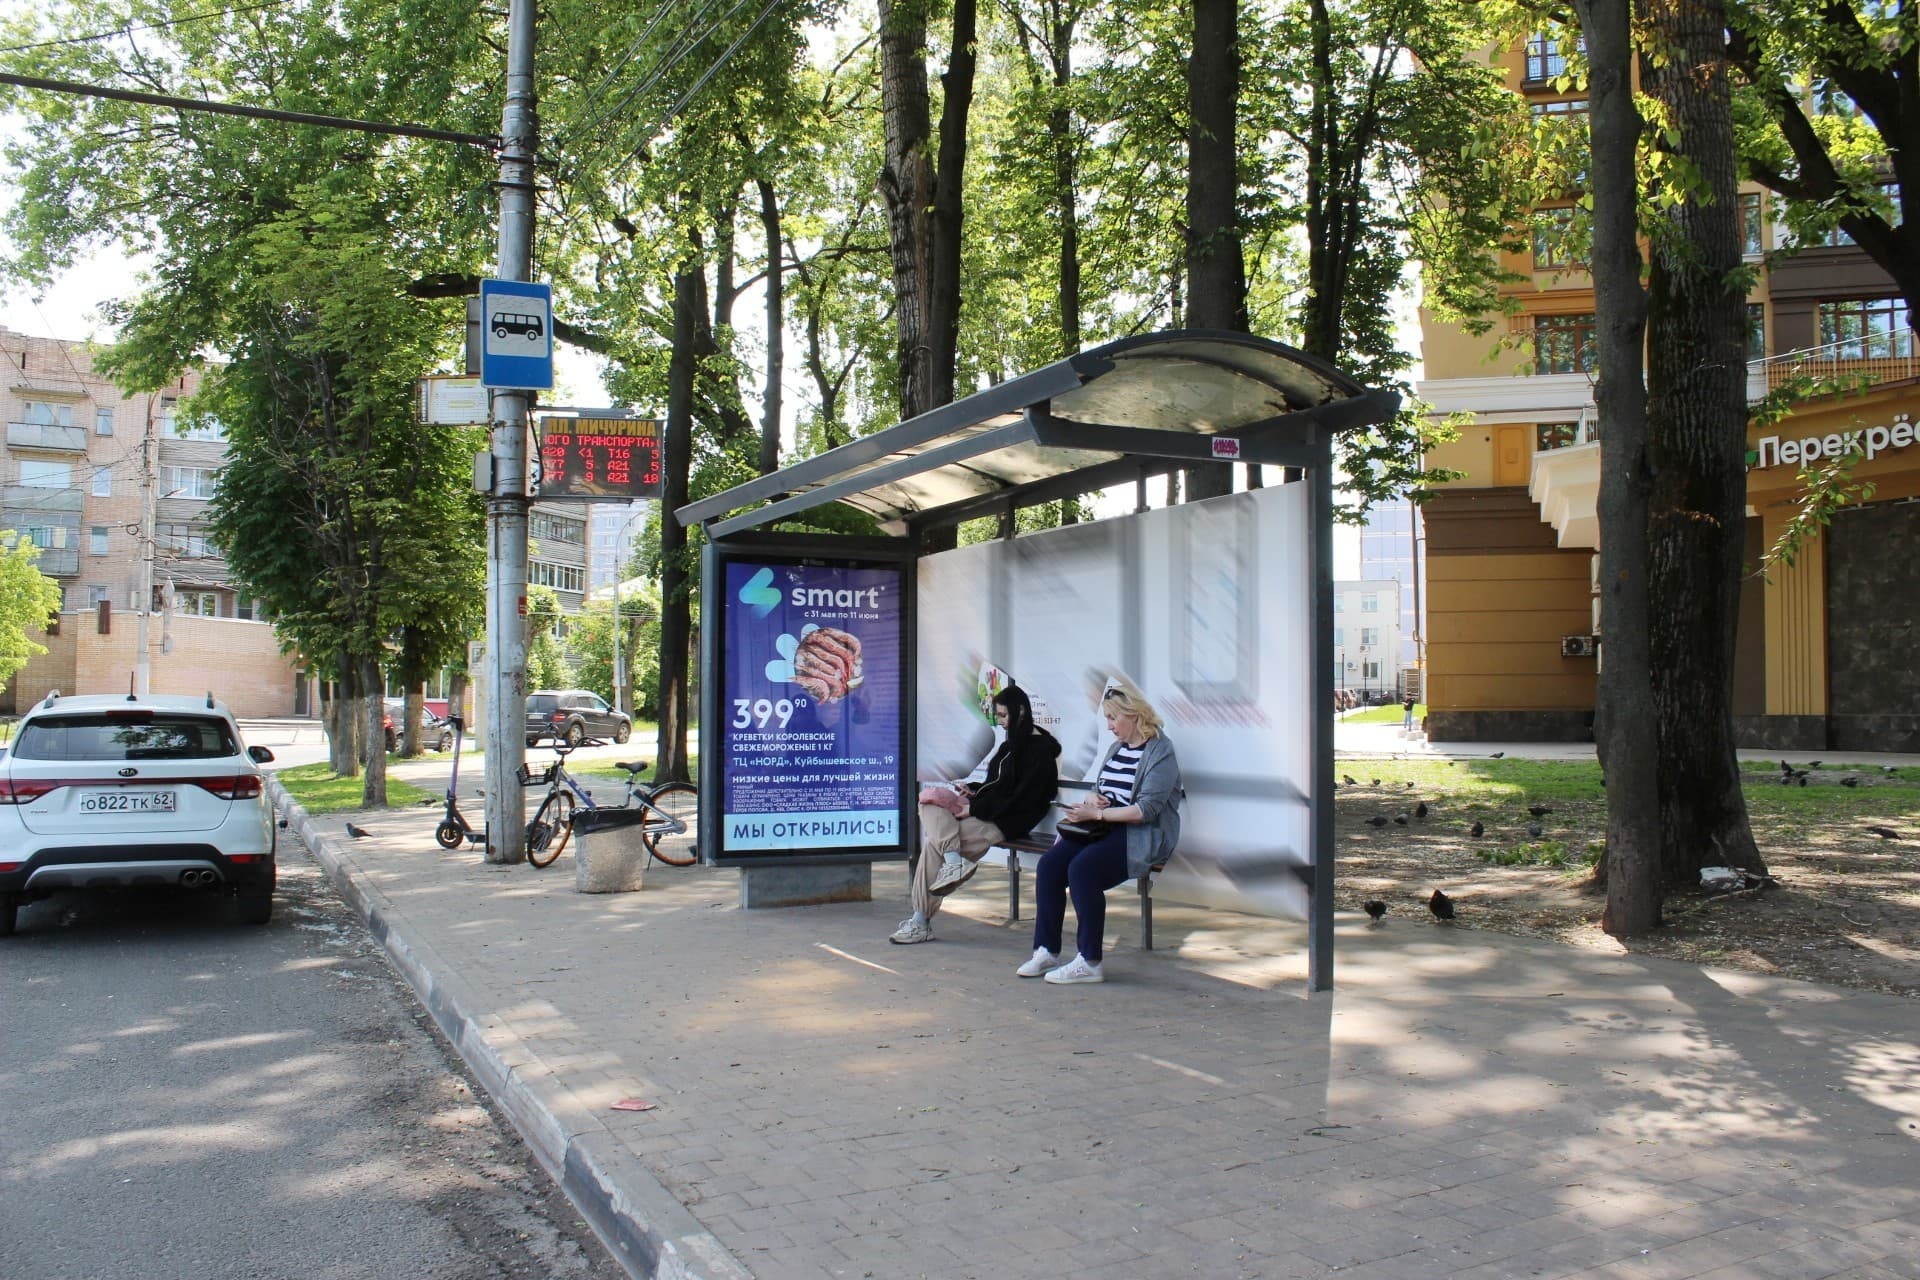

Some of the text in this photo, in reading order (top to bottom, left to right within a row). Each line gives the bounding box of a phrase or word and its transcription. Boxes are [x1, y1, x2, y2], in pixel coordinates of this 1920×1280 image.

[576, 419, 657, 436] МИЧУРИНА
[791, 587, 879, 609] smart
[811, 610, 819, 618] 31
[732, 699, 794, 729] 399
[733, 732, 836, 741] КРЕВЕТКИ КОРОЛЕВСКИЕ
[732, 743, 817, 752] СВЕЖЕМОРОЖЕНЫЕ
[823, 743, 833, 751] КГ
[733, 757, 748, 768] ТЦ
[794, 756, 867, 768] Куйбышевское
[884, 755, 894, 765] 19
[732, 772, 895, 784] низкие цены для лучшей жизни
[153, 794, 169, 805] 62
[733, 820, 893, 839] МЫ ОТКРЫЛИСЬ!
